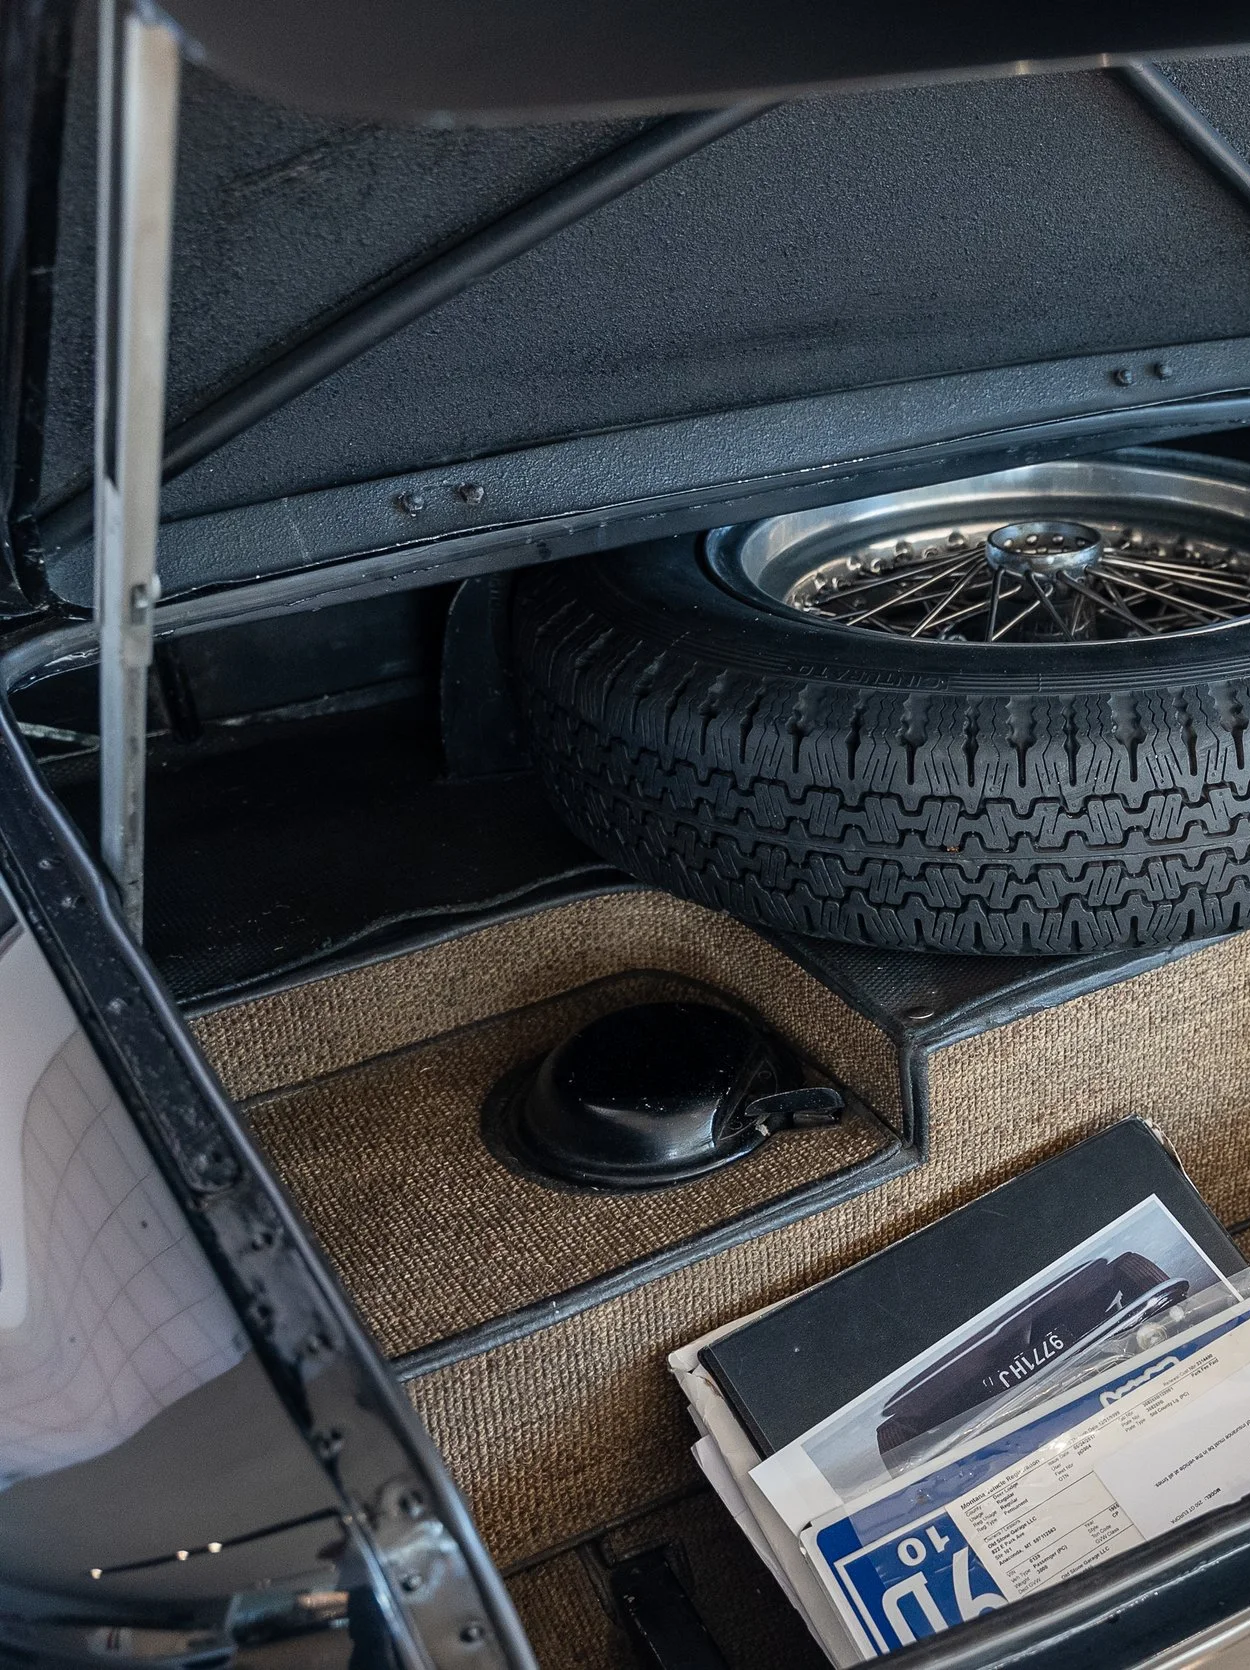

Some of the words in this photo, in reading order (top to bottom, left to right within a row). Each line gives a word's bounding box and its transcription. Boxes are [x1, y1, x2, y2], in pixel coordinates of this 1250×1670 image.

[1224, 1423, 1246, 1440] insurance
[1178, 1458, 1195, 1472] vehicle
[960, 1491, 985, 1509] Montana
[996, 1491, 1014, 1505] Regular
[1203, 1487, 1220, 1501] MODEL:
[1000, 1497, 1018, 1510] Regular
[1170, 1509, 1189, 1524] EUROPA
[996, 1532, 1010, 1543] Stone
[1010, 1522, 1027, 1535] Garage
[898, 1525, 950, 1567] 10
[1033, 1551, 1057, 1568] Passenger
[1070, 1563, 1083, 1573] Stone
[1083, 1552, 1100, 1565] Garage
